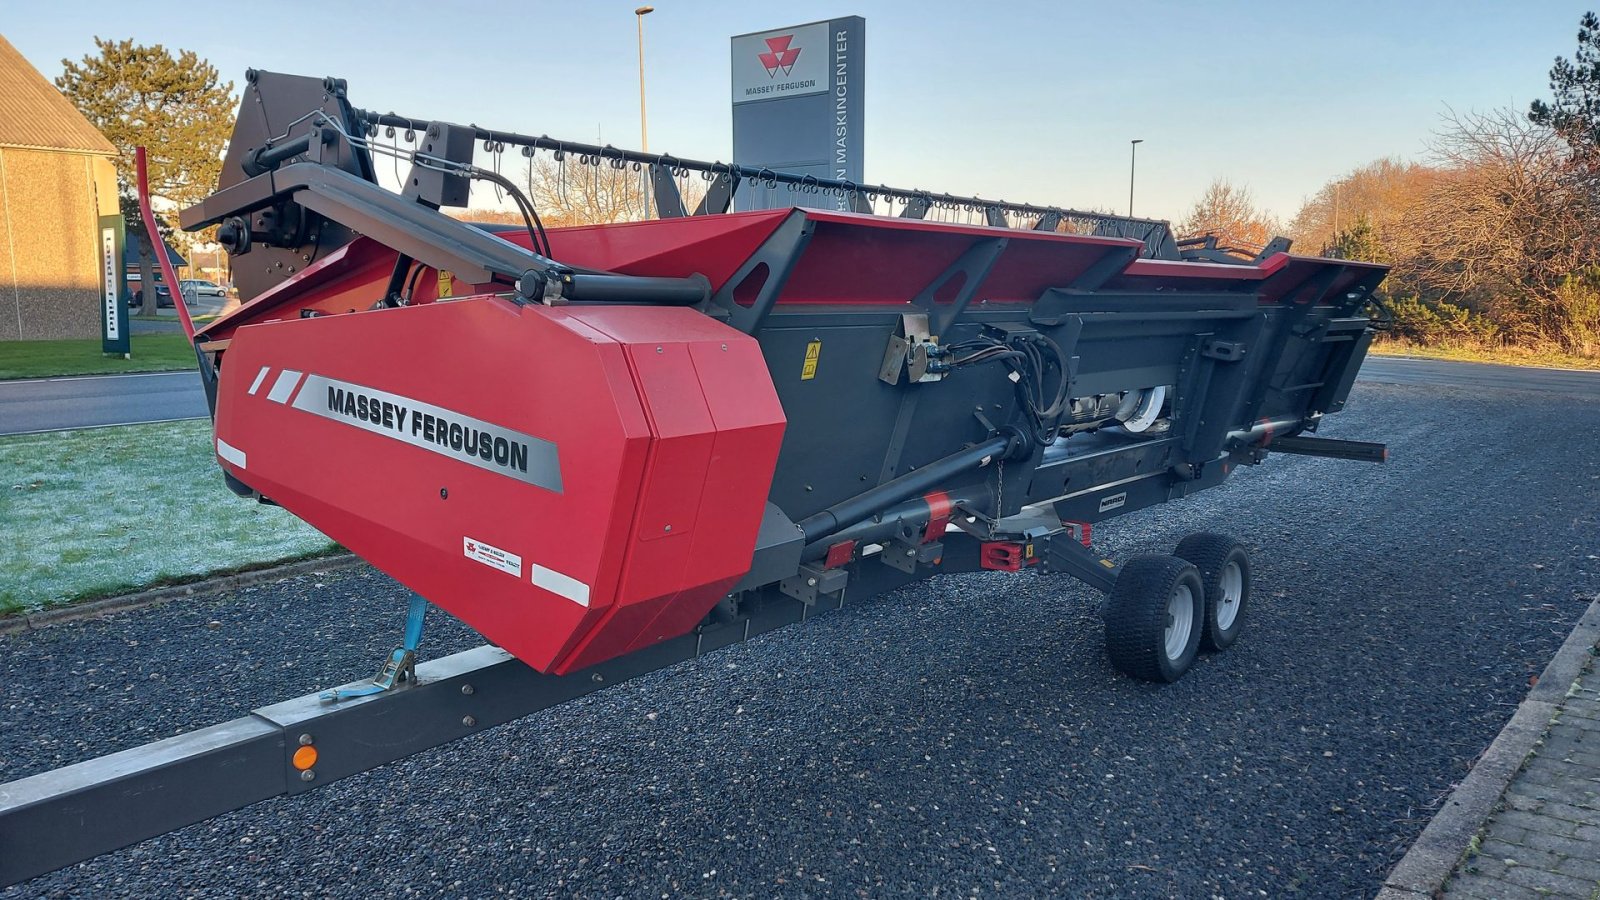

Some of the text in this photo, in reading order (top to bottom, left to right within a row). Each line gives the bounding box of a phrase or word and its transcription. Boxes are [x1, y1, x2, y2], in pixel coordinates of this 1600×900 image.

[745, 79, 816, 96] MASSEY FERGUSON
[836, 30, 847, 163] MASKINCENTER
[327, 386, 528, 473] MASSEY FERGUSON
